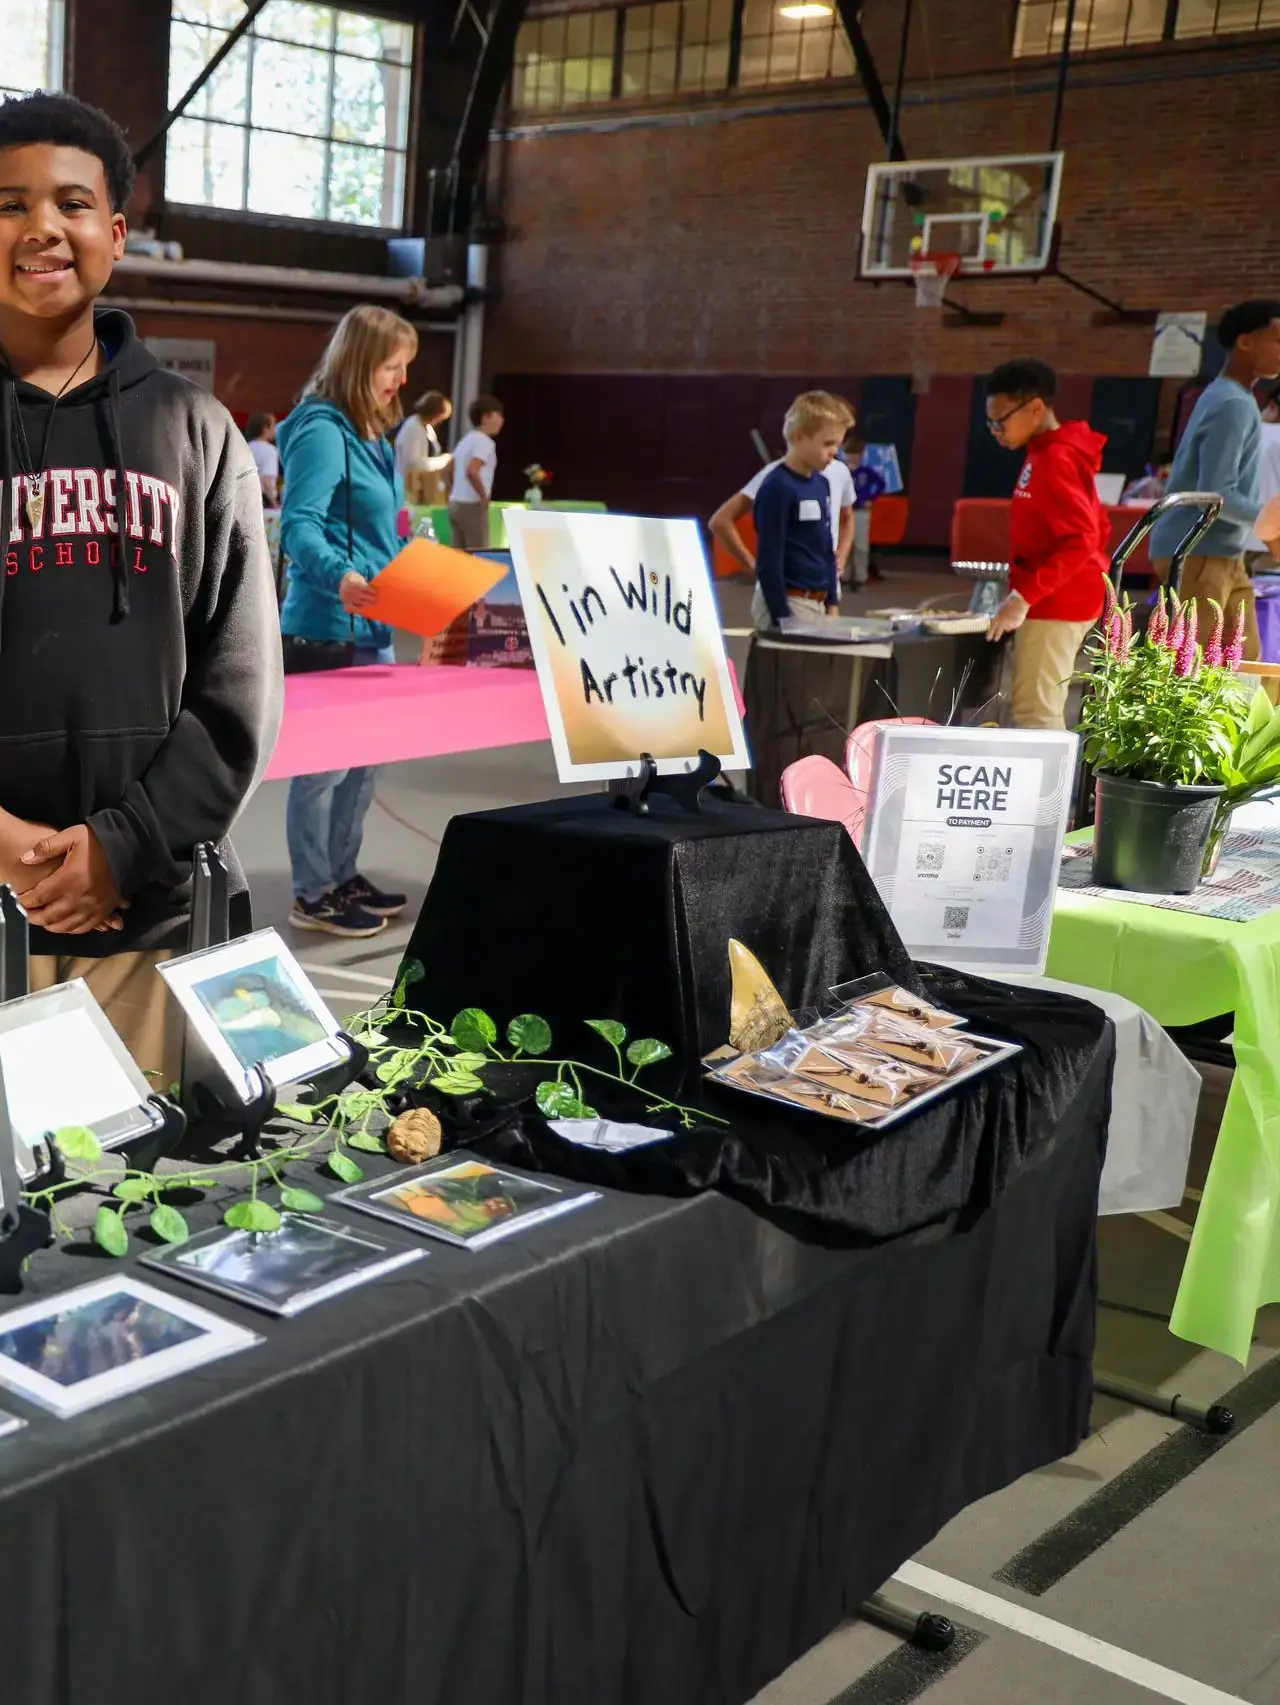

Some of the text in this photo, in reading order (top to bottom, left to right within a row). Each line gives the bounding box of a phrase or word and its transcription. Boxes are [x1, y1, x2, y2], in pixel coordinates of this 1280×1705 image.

[562, 583, 608, 636] in
[609, 562, 694, 636] Wild
[580, 653, 706, 722] Artistry
[937, 764, 1012, 787] SCAN
[936, 788, 1008, 811] HERE
[948, 818, 990, 827] TO PAYMENT
